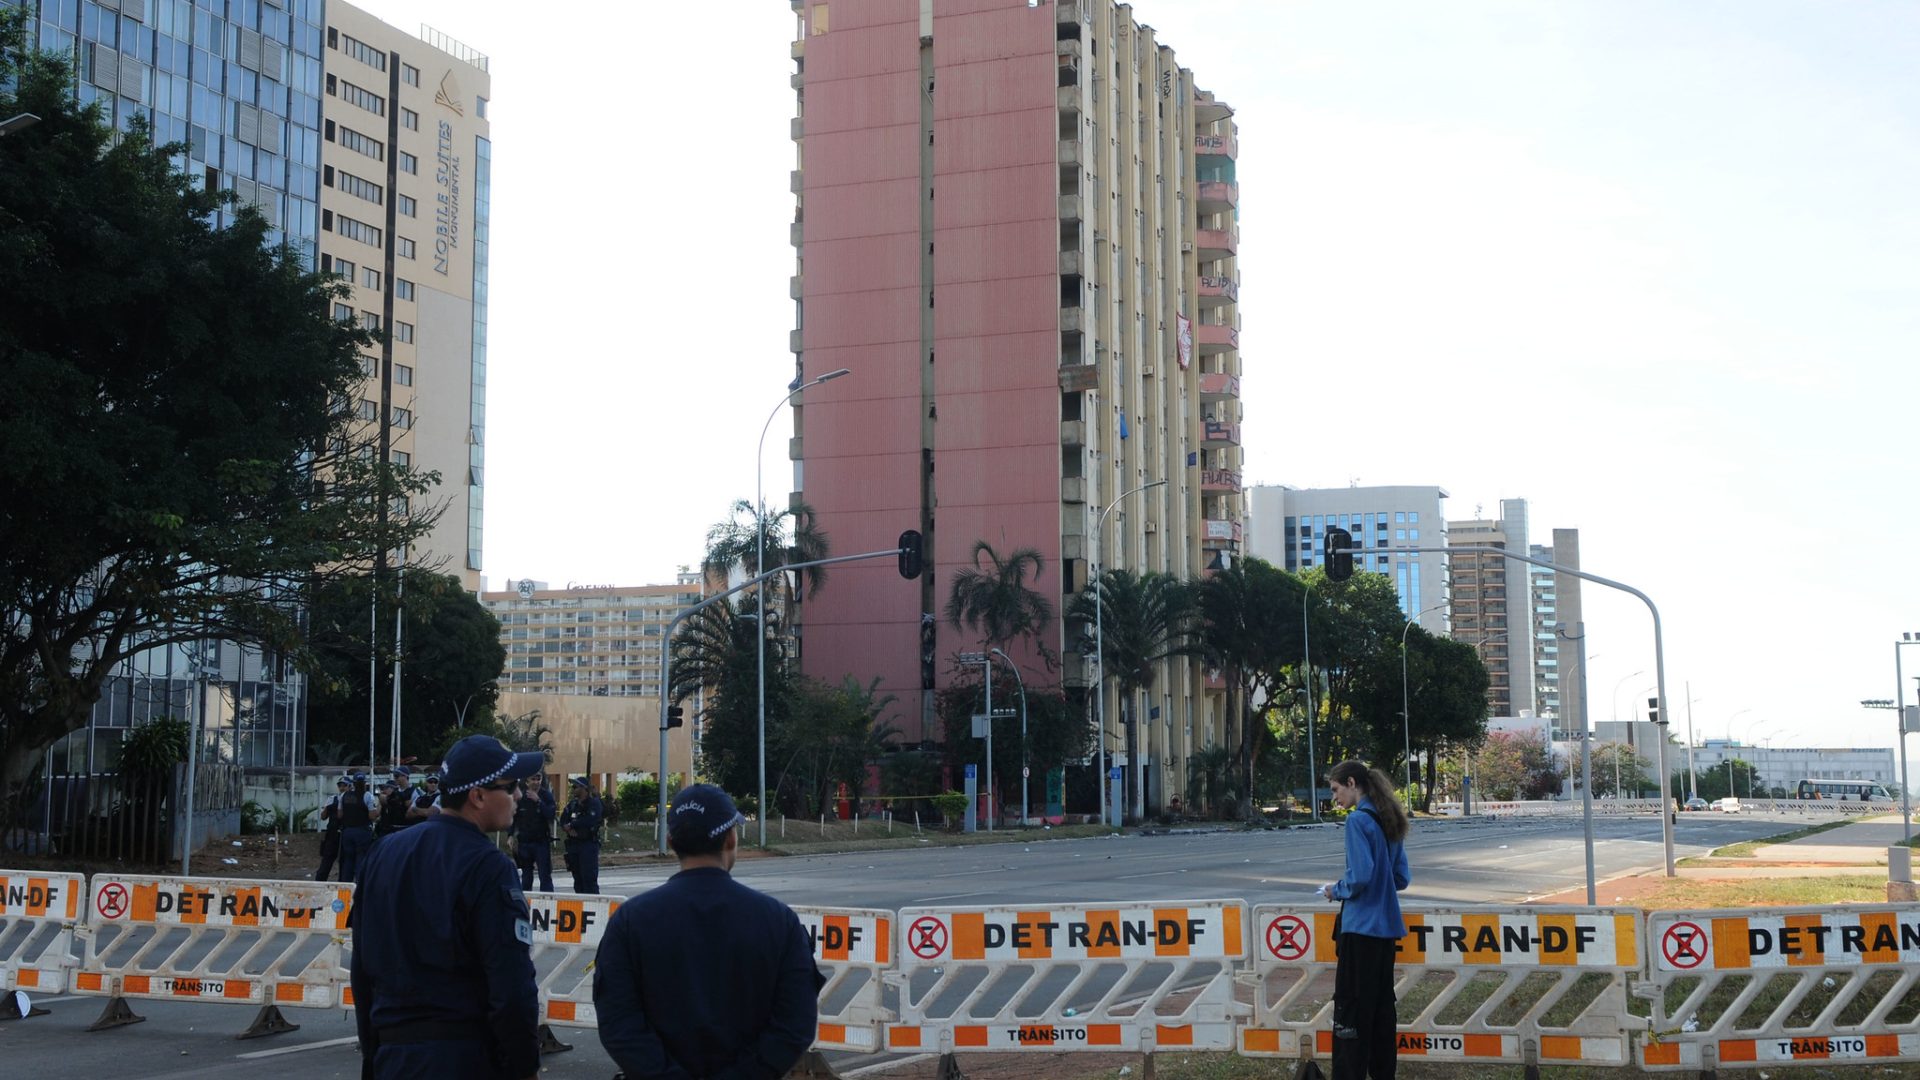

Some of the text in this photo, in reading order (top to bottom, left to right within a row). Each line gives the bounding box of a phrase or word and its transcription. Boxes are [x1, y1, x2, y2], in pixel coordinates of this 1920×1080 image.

[434, 121, 450, 276] NOBILE SUITES
[449, 156, 460, 249] MONUMENTAL
[675, 800, 705, 815] POLÍCIA
[532, 908, 596, 933] N-DF
[983, 919, 1206, 949] DETRAN-DF
[1747, 923, 1920, 956] DETRAN
[163, 979, 223, 993] TRÂNSITO
[1007, 1027, 1087, 1041] TRÂNSITO
[1777, 1038, 1865, 1055] TRÂNSITO
